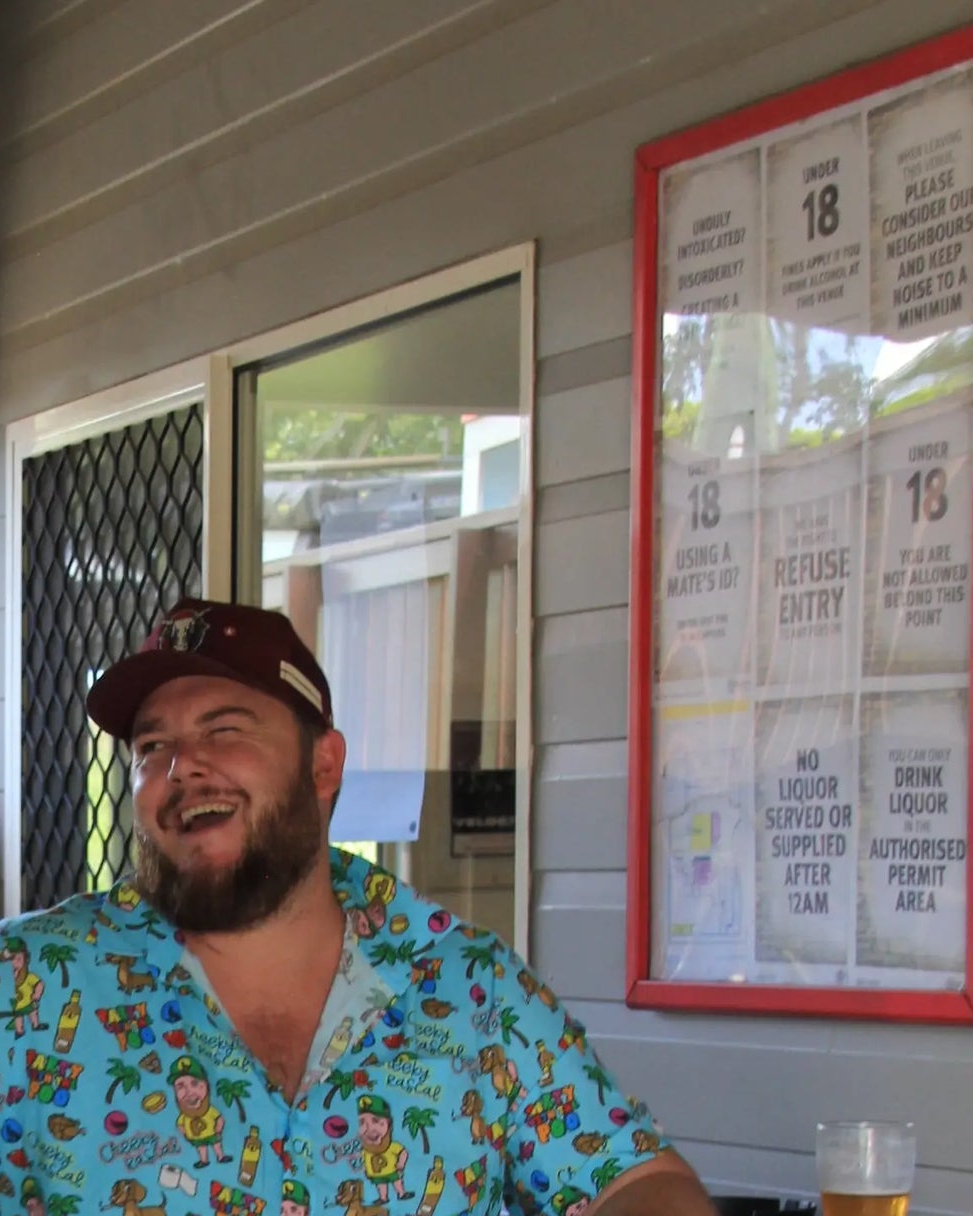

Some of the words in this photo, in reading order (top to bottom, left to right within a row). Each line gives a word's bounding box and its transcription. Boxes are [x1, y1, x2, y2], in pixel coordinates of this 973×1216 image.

[802, 156, 840, 184] UNDER
[905, 168, 955, 204] PLEASE
[693, 210, 731, 236] UNDULY
[802, 184, 840, 242] 18
[882, 197, 947, 238] CONSIDER
[677, 226, 746, 260] INTOXICATED?
[886, 212, 973, 260] NEIGHBOURS
[806, 249, 832, 271] APPLY
[848, 260, 860, 277] AT
[898, 254, 925, 282] AND
[928, 241, 962, 271] KEEP
[678, 258, 744, 291] DISORDERLY?
[893, 276, 933, 307] NOISE
[936, 269, 954, 292] TO
[958, 264, 968, 285] A
[898, 291, 962, 330] MINIMUM
[909, 440, 948, 463] UNDER
[688, 480, 721, 532] 18
[906, 467, 948, 523] 18
[676, 543, 718, 570] USING
[722, 541, 731, 562] A
[774, 546, 851, 588] REFUSE
[927, 544, 951, 562] ARE
[667, 570, 716, 598] MATE'S
[719, 565, 740, 590] ID?
[883, 569, 908, 589] NOT
[908, 563, 967, 586] ALLOWED
[779, 586, 845, 625] ENTRY
[936, 585, 966, 605] THIS
[905, 608, 943, 629] POINT
[797, 747, 819, 773] NO
[779, 775, 838, 804] LIQUOR
[895, 765, 944, 788] DRINK
[765, 805, 824, 831] SERVED
[828, 803, 852, 829] OR
[889, 792, 948, 818] LIQUOR
[771, 834, 846, 860] SUPPLIED
[869, 837, 966, 861] AUTHORISED
[785, 863, 831, 887] AFTER
[888, 864, 946, 887] PERMIT
[789, 891, 828, 915] 12AM
[895, 890, 936, 913] AREA
